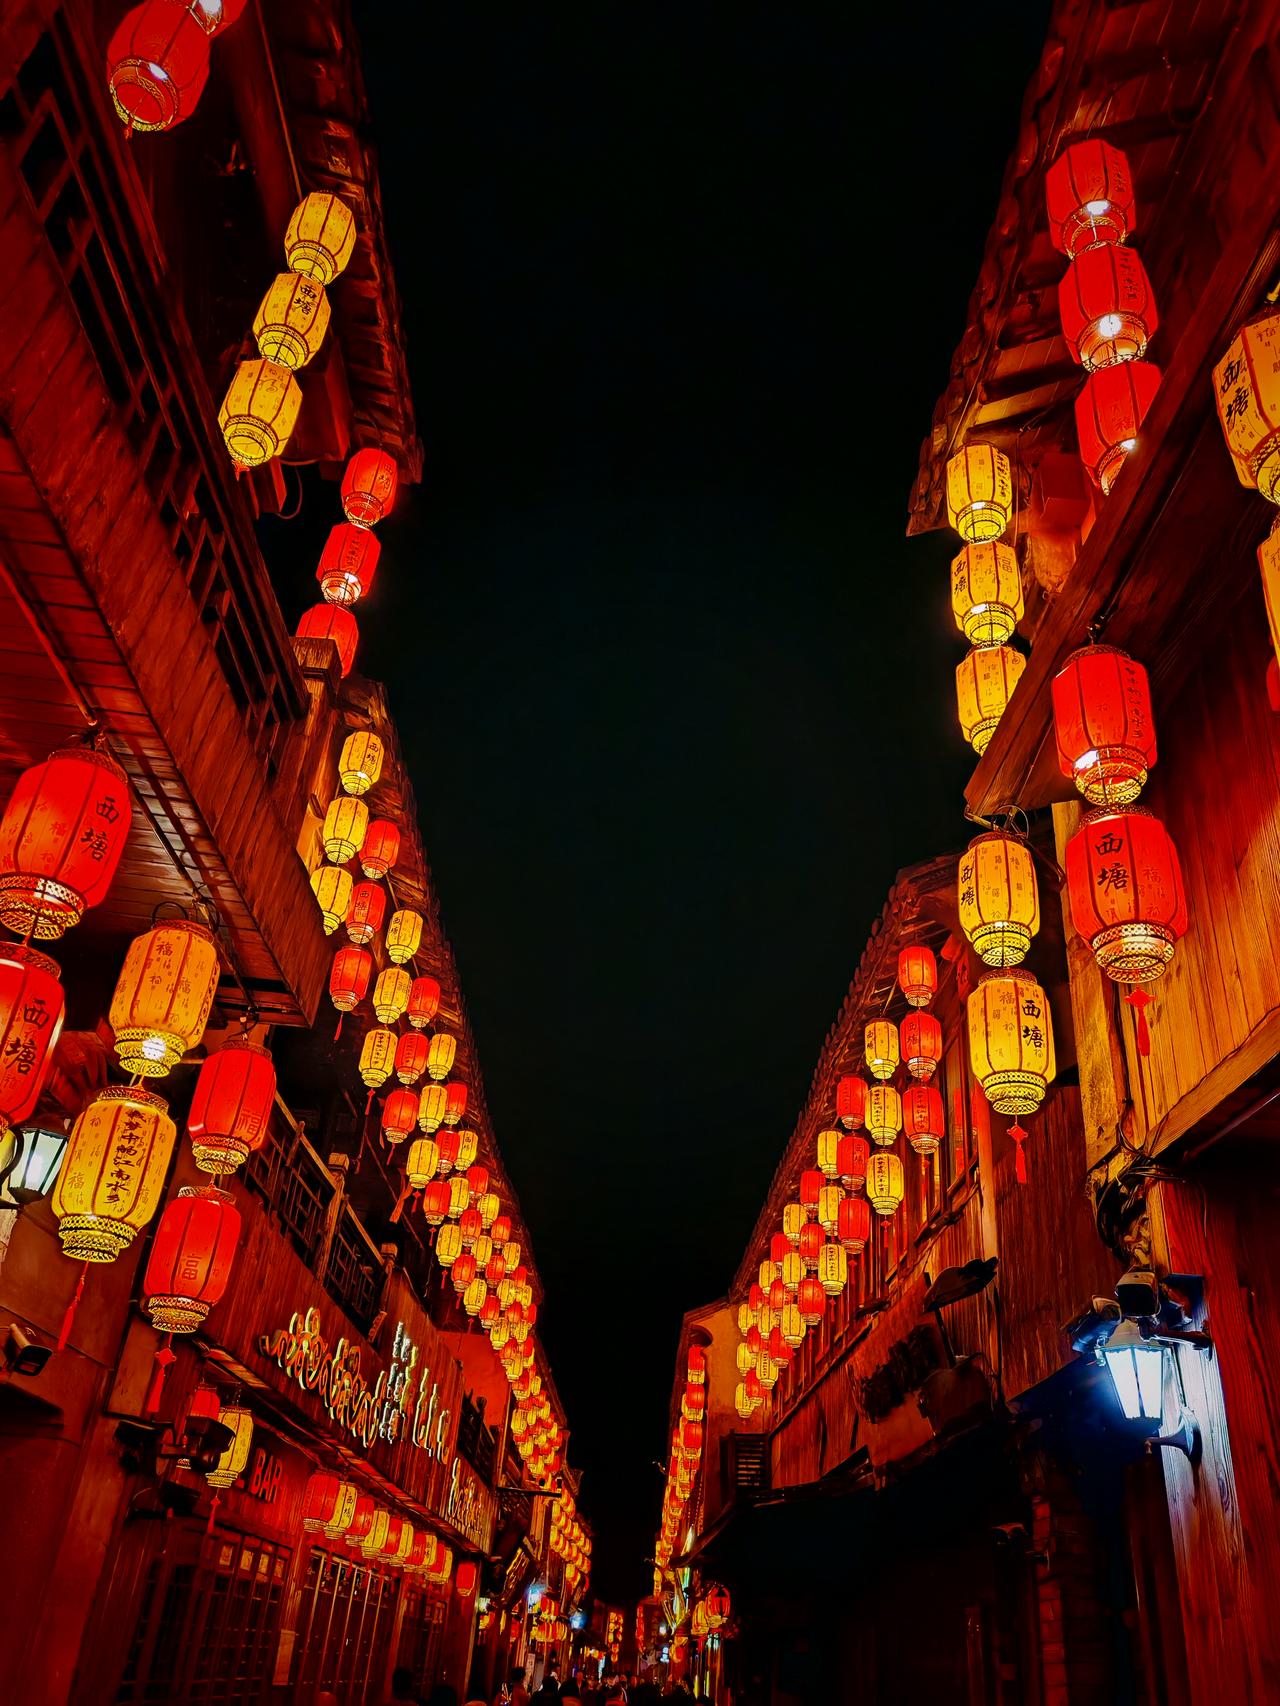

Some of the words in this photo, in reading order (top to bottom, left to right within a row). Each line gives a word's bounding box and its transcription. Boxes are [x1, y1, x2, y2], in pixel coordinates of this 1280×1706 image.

[294, 284, 317, 315] 西塘
[1221, 359, 1249, 428] 西塘
[953, 559, 966, 596] 西塘
[366, 743, 378, 763] 西塘
[81, 796, 120, 862] 西塘
[961, 865, 975, 906] 西塘
[1094, 833, 1130, 896] 西塘
[5, 999, 50, 1075] 西塘
[1022, 999, 1044, 1048] 西塘
[251, 1448, 282, 1504] BAR
